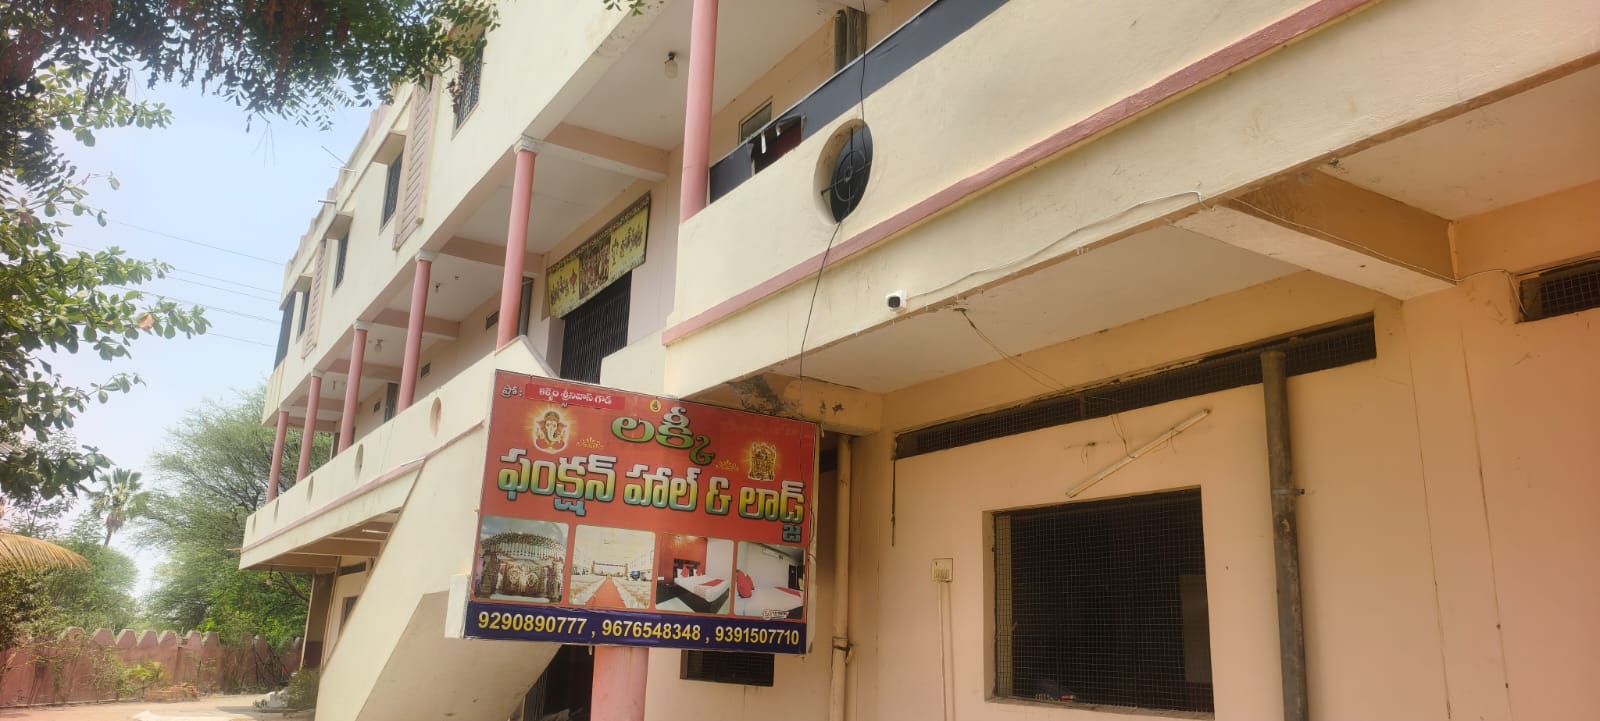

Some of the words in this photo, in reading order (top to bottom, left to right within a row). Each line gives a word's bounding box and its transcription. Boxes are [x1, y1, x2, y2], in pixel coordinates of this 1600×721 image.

[611, 406, 716, 466] లక్కీ
[497, 447, 617, 517] ఫంక్షన్
[623, 463, 701, 512] హాల్
[477, 610, 587, 635] 9290890777
[602, 619, 701, 642] 9676548348
[714, 624, 800, 646] 9391507710
